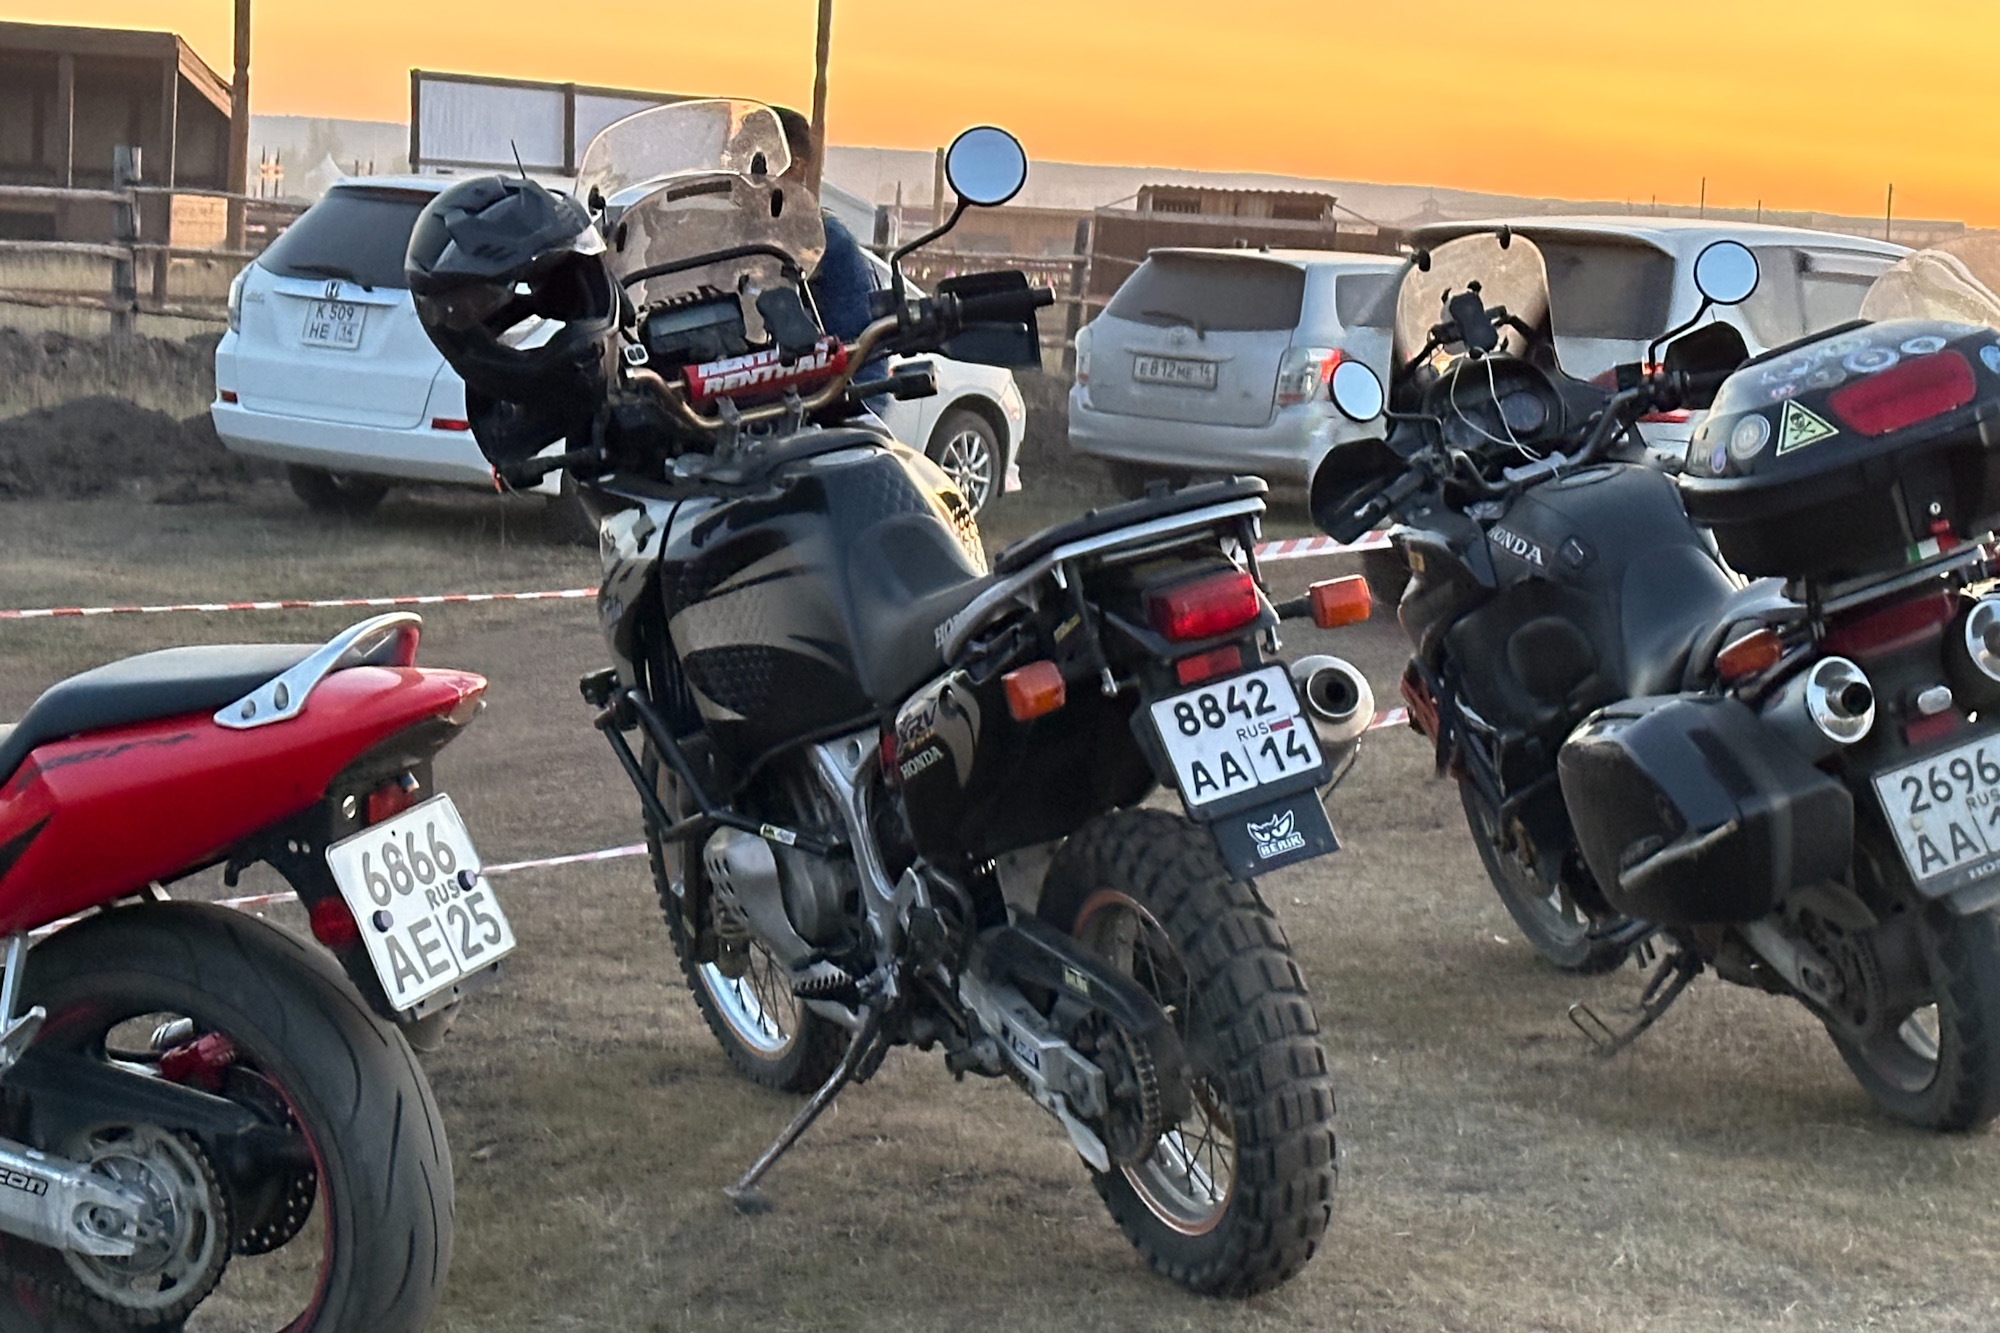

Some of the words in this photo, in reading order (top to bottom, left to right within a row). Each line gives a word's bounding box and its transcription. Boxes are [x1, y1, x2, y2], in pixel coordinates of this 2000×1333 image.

[309, 322, 330, 339] HE
[1486, 525, 1544, 567] HONDA
[1174, 679, 1277, 736] 8842
[1236, 722, 1269, 741] RUS
[900, 745, 944, 781] HONDA
[1191, 751, 1249, 796] AA
[1260, 730, 1311, 772] 14
[1901, 748, 2000, 814] 2696
[362, 821, 457, 906] 6866
[1918, 822, 1980, 873] AA
[425, 879, 461, 911] RUS
[385, 917, 451, 994] AE
[447, 892, 501, 960] 25
